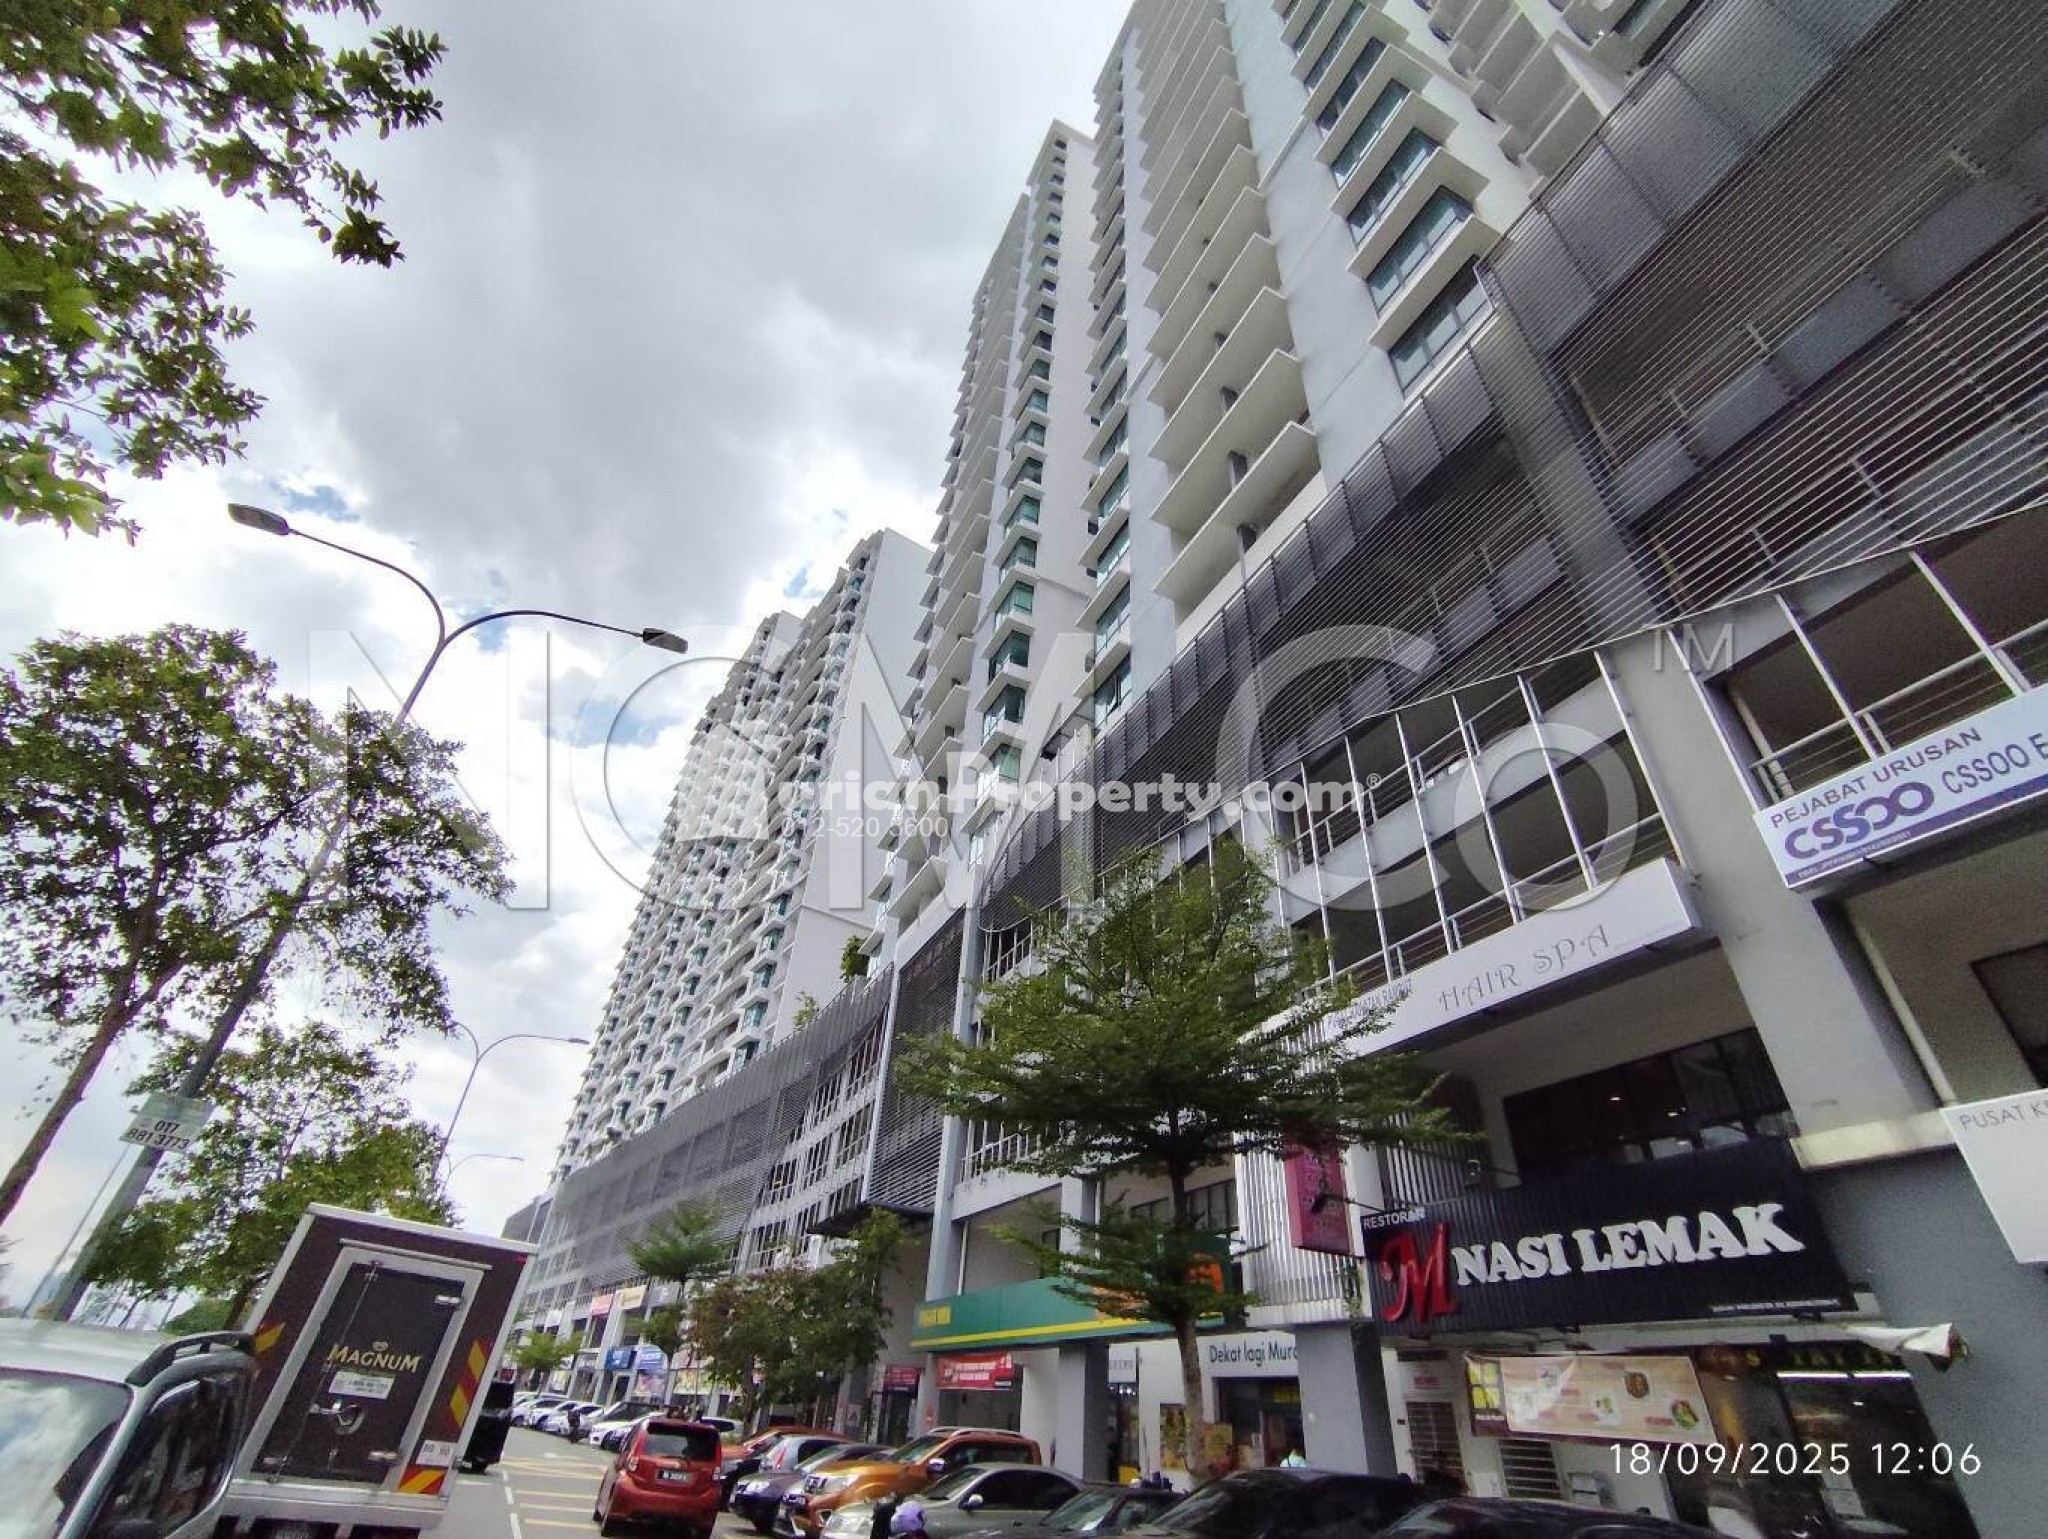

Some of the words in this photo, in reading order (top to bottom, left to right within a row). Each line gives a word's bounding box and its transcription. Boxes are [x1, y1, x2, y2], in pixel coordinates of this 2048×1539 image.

[1770, 776, 1868, 828] PEJABAT
[1873, 727, 1982, 782] URUSAN
[1941, 743, 2031, 794] CSSOO
[1438, 963, 1520, 1013] HAIR
[1533, 924, 1611, 976] SPA
[154, 1120, 180, 1133] 017
[1959, 1103, 2024, 1130] PUSAT
[2030, 1100, 2048, 1118] K
[1450, 1233, 1572, 1286] NASI
[1572, 1203, 1805, 1273] LEMAK
[326, 1344, 422, 1373] MAGNUM
[1209, 1341, 1241, 1363] Dekat
[1243, 1339, 1266, 1367] lagi
